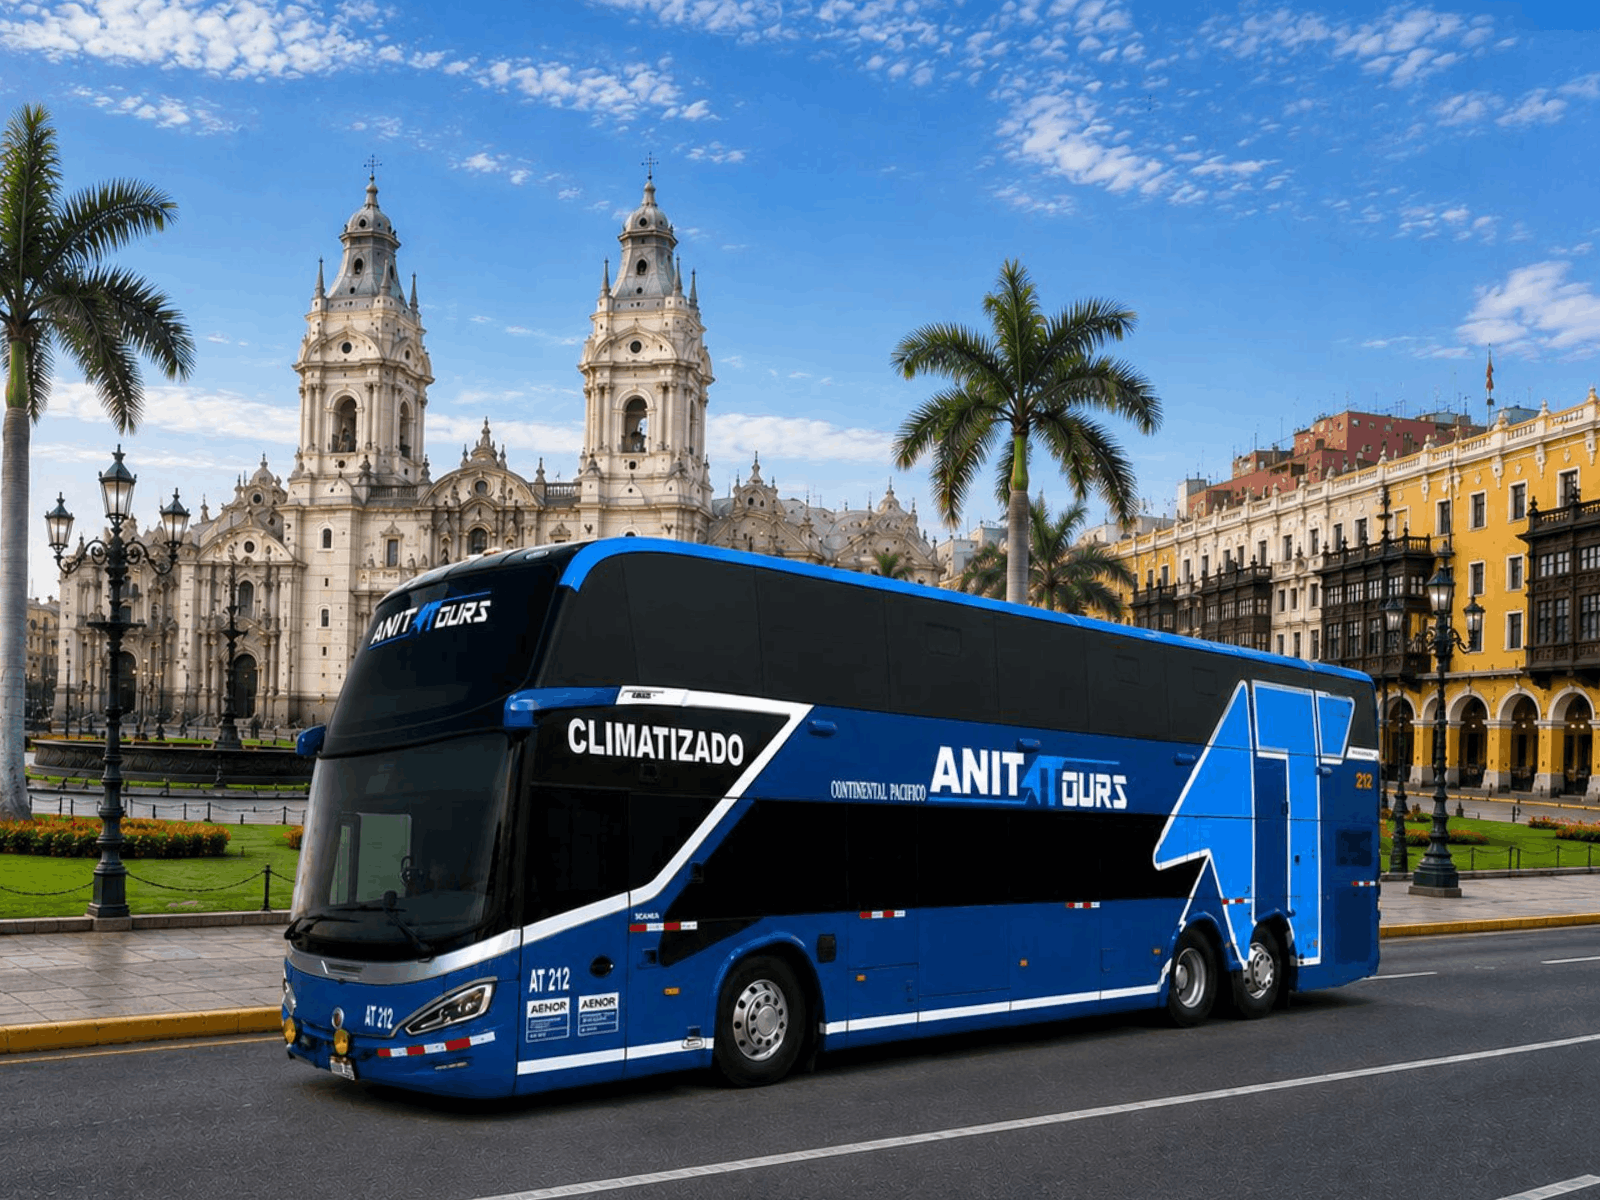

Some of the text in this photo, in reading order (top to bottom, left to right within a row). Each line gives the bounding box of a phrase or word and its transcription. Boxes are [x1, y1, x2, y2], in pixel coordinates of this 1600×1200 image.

[567, 717, 744, 766] CLIMATIZADO
[830, 780, 927, 801] CONTINENTAL PACIFICO
[1356, 772, 1373, 789] 212
[528, 966, 570, 993] AT 212
[530, 1001, 567, 1014] AENOR
[581, 997, 616, 1010] AENOR
[364, 1004, 394, 1029] AT 212
